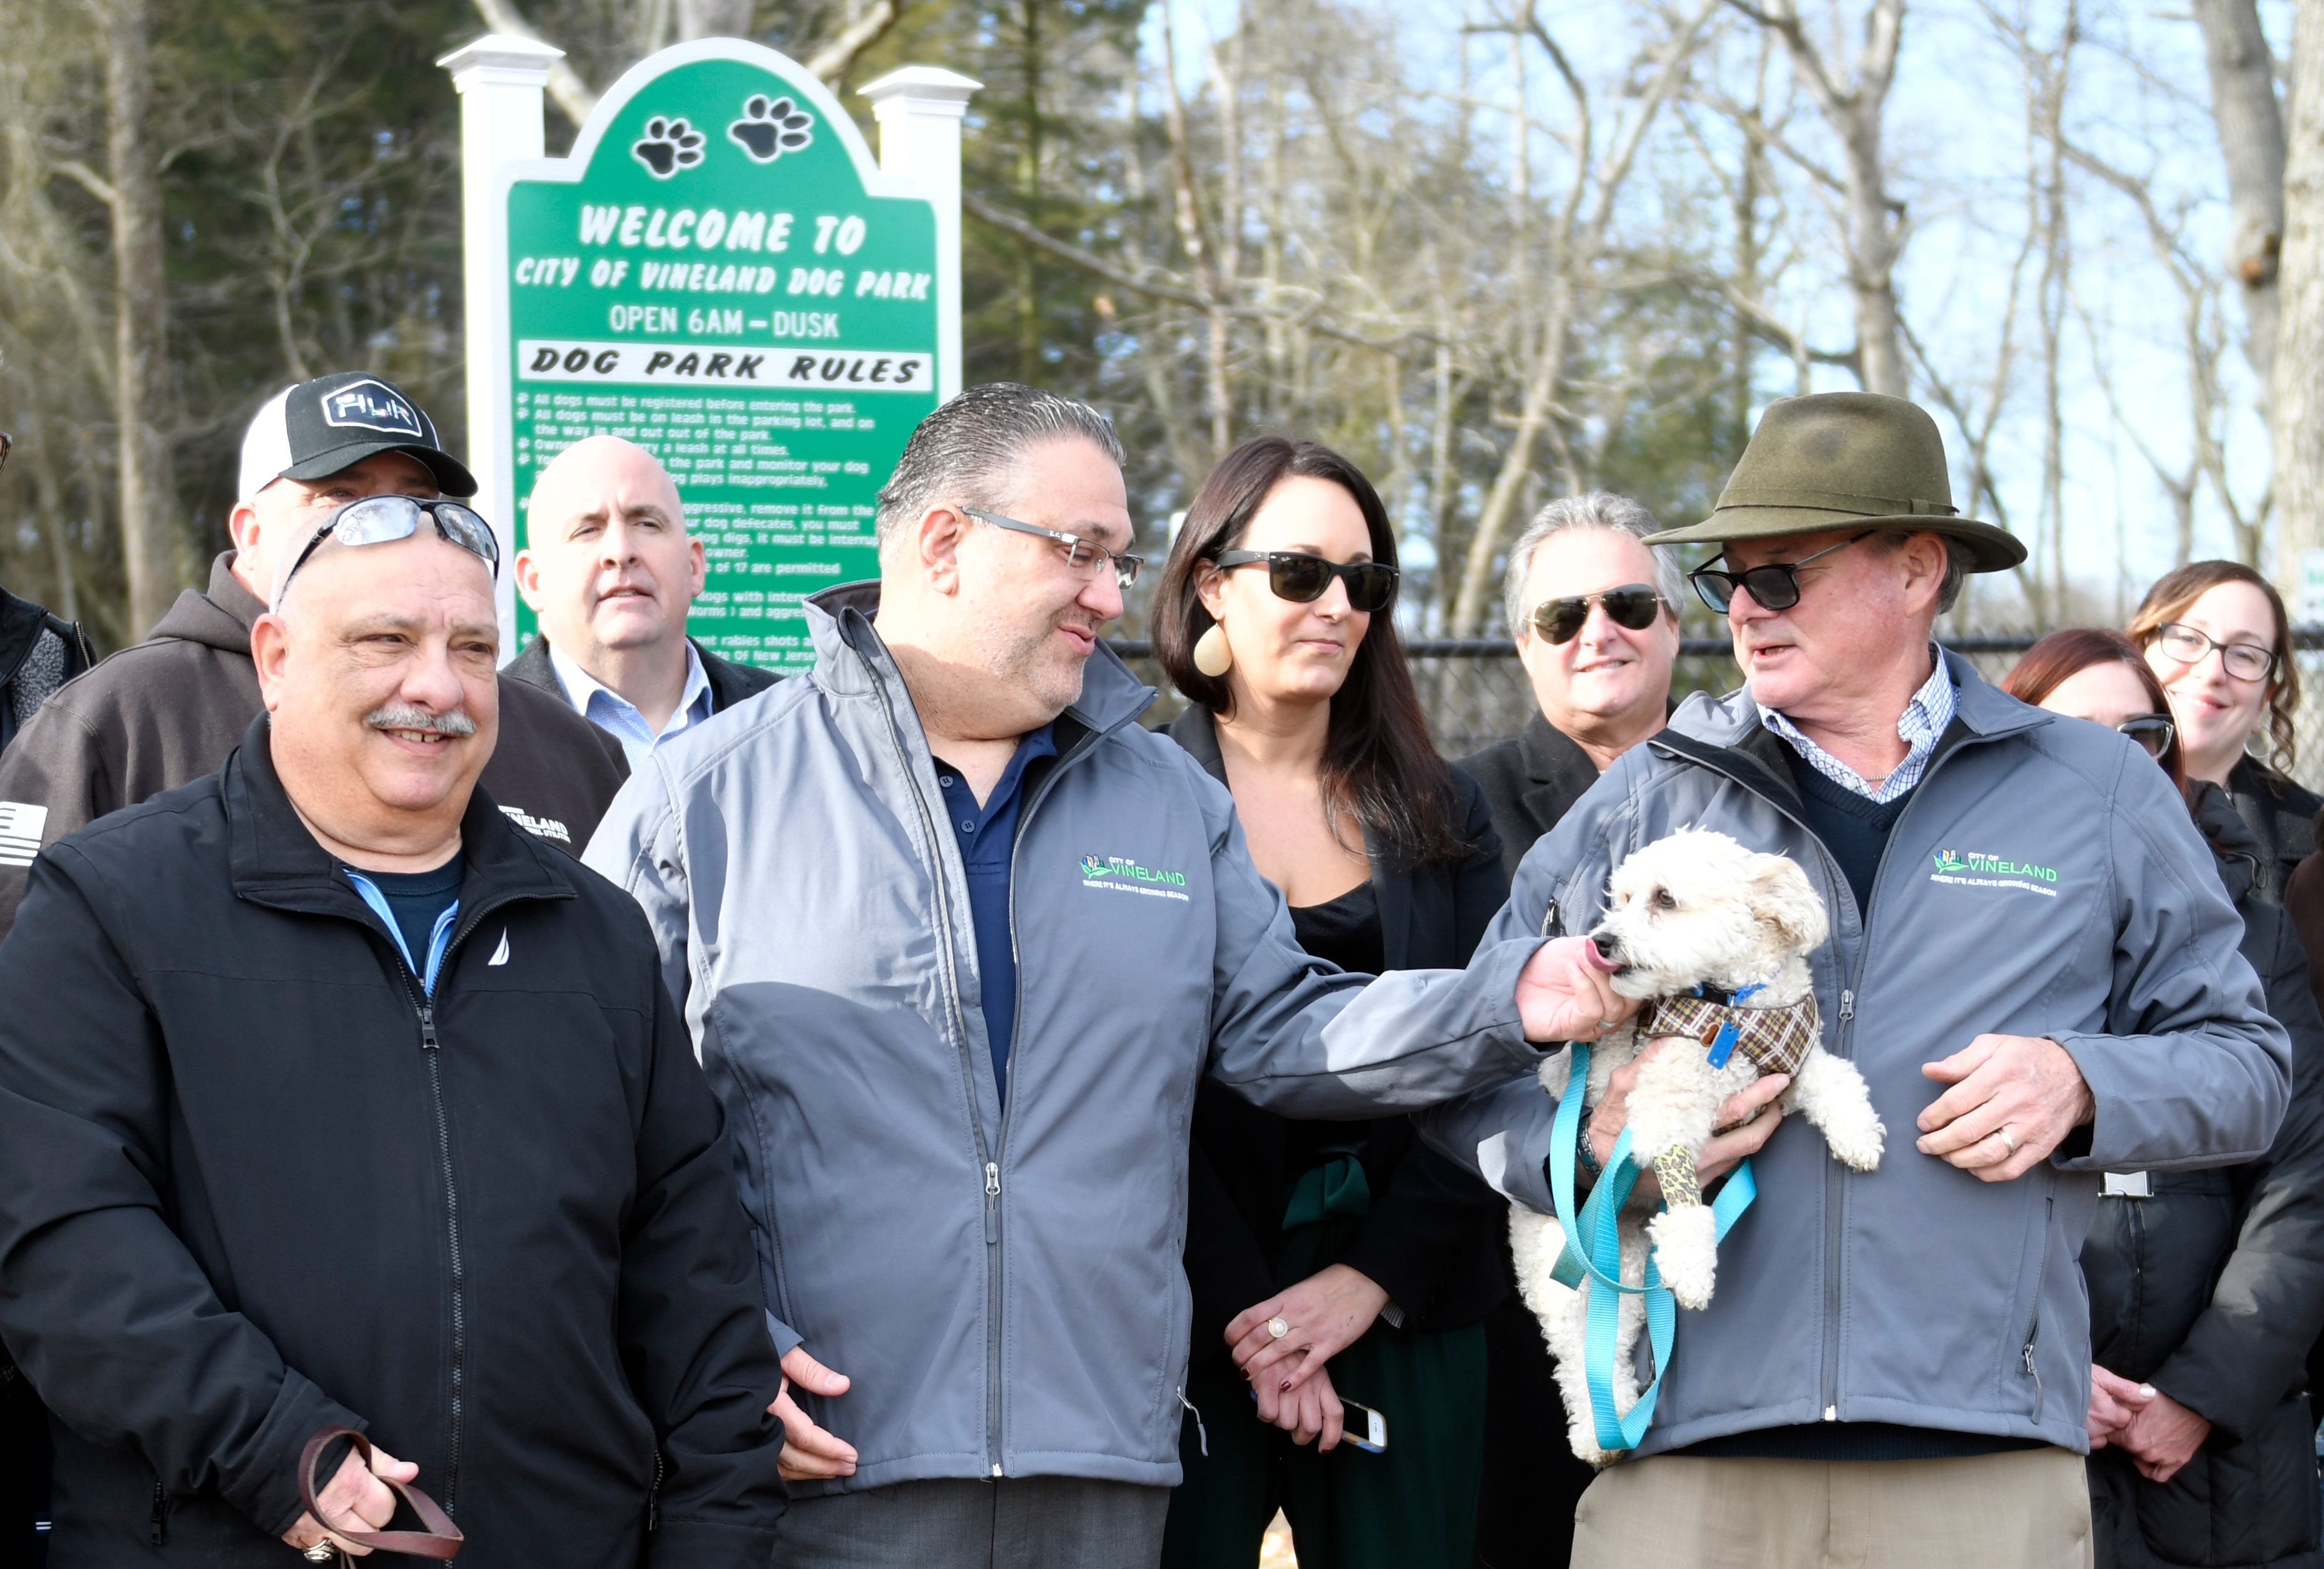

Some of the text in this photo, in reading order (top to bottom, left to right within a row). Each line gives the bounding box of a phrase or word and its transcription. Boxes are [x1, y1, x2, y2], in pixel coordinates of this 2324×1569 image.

[579, 205, 866, 255] WELCOME TO
[516, 258, 930, 300] CITY OF VINELAND DOG PARK
[609, 305, 677, 333] OPEN
[689, 308, 742, 335] 6AM
[774, 312, 840, 338] DUSK
[531, 347, 921, 383] DOG PARK RULES
[534, 394, 855, 414] All dogs must be registered before entering the park.
[534, 409, 875, 429] All dogs must be on leash in the parking lot, and on
[534, 424, 772, 441] the way in and out out of the park.
[663, 443, 671, 453] a
[676, 444, 708, 454] leash
[713, 444, 726, 454] at
[731, 444, 747, 454] all
[751, 444, 789, 455] times.
[669, 457, 691, 467] the
[695, 459, 724, 469] park
[729, 459, 753, 469] and
[757, 459, 808, 470] monitor
[812, 462, 840, 472] your
[843, 461, 869, 474] dog
[670, 472, 828, 487] og plays inappropriately,
[683, 502, 874, 515] ggressive, remove it from the
[704, 517, 728, 530] dog
[732, 518, 797, 530] defecates,
[801, 520, 823, 531] you
[828, 520, 859, 530] must
[757, 533, 768, 544] it
[772, 534, 805, 544] must
[808, 534, 824, 544] be
[828, 534, 879, 546] interrup
[715, 562, 730, 572] of
[735, 562, 748, 572] 17
[752, 564, 772, 573] are
[775, 563, 840, 575] permitted
[697, 591, 728, 604] dogs
[733, 591, 763, 602] with
[739, 606, 763, 617] and
[766, 607, 805, 619] aggres
[721, 635, 760, 646] rabies
[764, 635, 799, 646] shots
[734, 650, 749, 661] Of
[753, 651, 780, 661] New
[785, 651, 816, 661] Jerse
[506, 813, 568, 836] NELAND
[1110, 862, 1187, 886] VINELAND
[1968, 858, 2058, 883] VINELAND
[1083, 879, 1103, 888] WHERE
[1115, 882, 1139, 893] ALWAYS
[1139, 887, 1166, 897] GROWING
[1166, 890, 1189, 901] SEASON
[1930, 874, 2056, 897] WHERE IT'S ALWAYS GROWING SEASON
